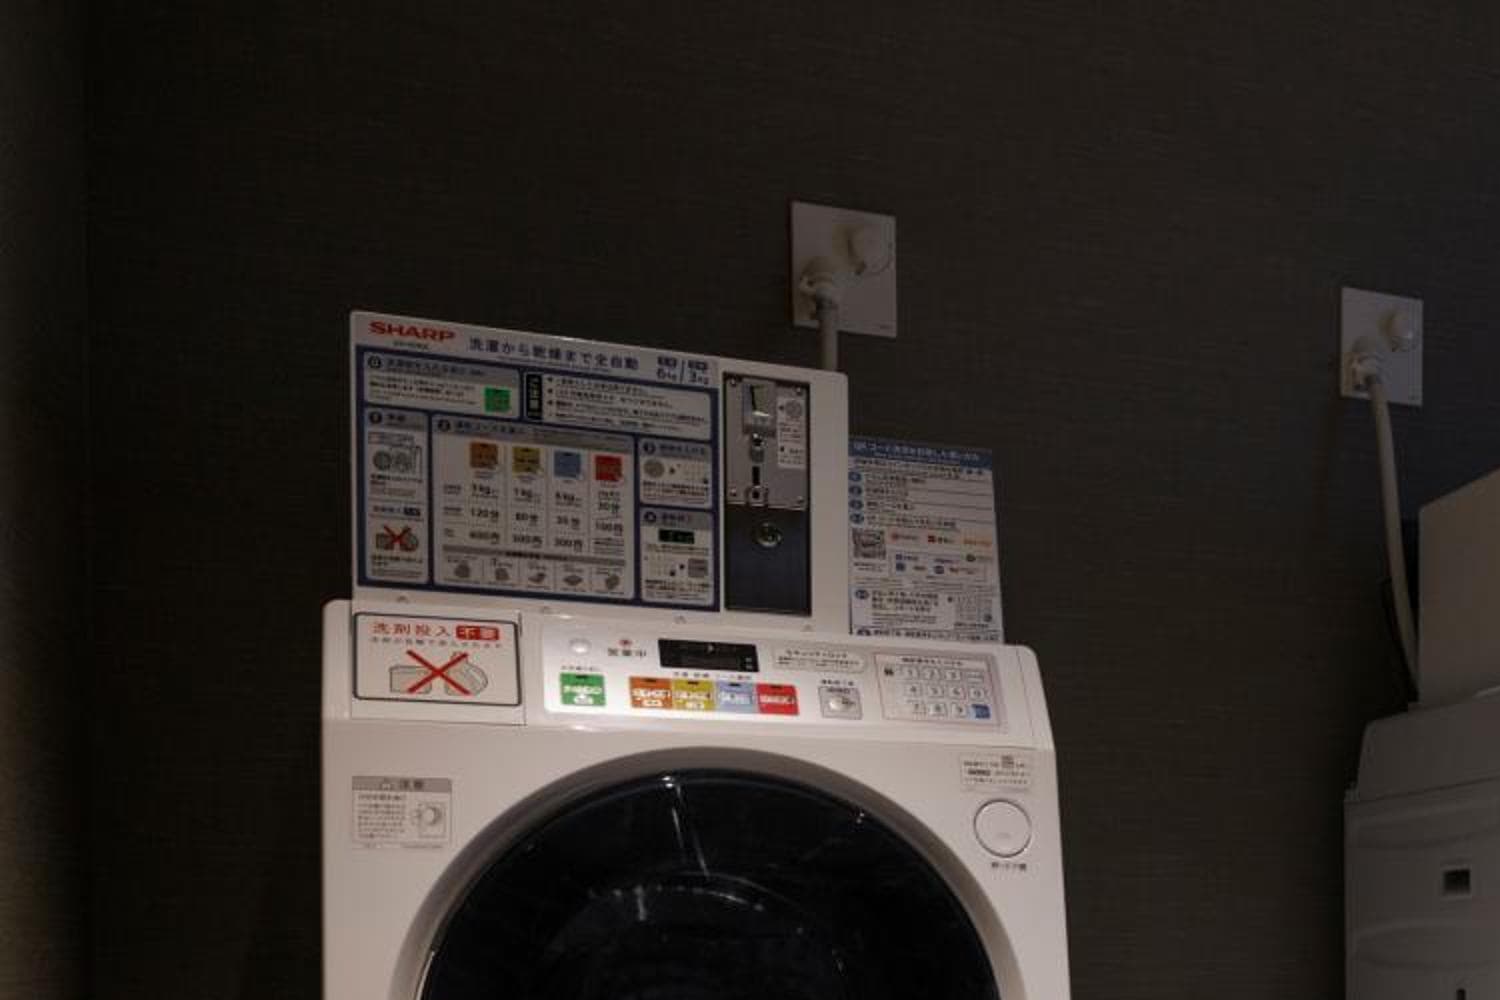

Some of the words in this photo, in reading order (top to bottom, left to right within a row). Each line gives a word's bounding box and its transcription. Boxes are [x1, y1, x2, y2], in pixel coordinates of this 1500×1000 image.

[369, 321, 456, 342] SHARP
[470, 337, 639, 370] 洗濯から乾燥まで全自動
